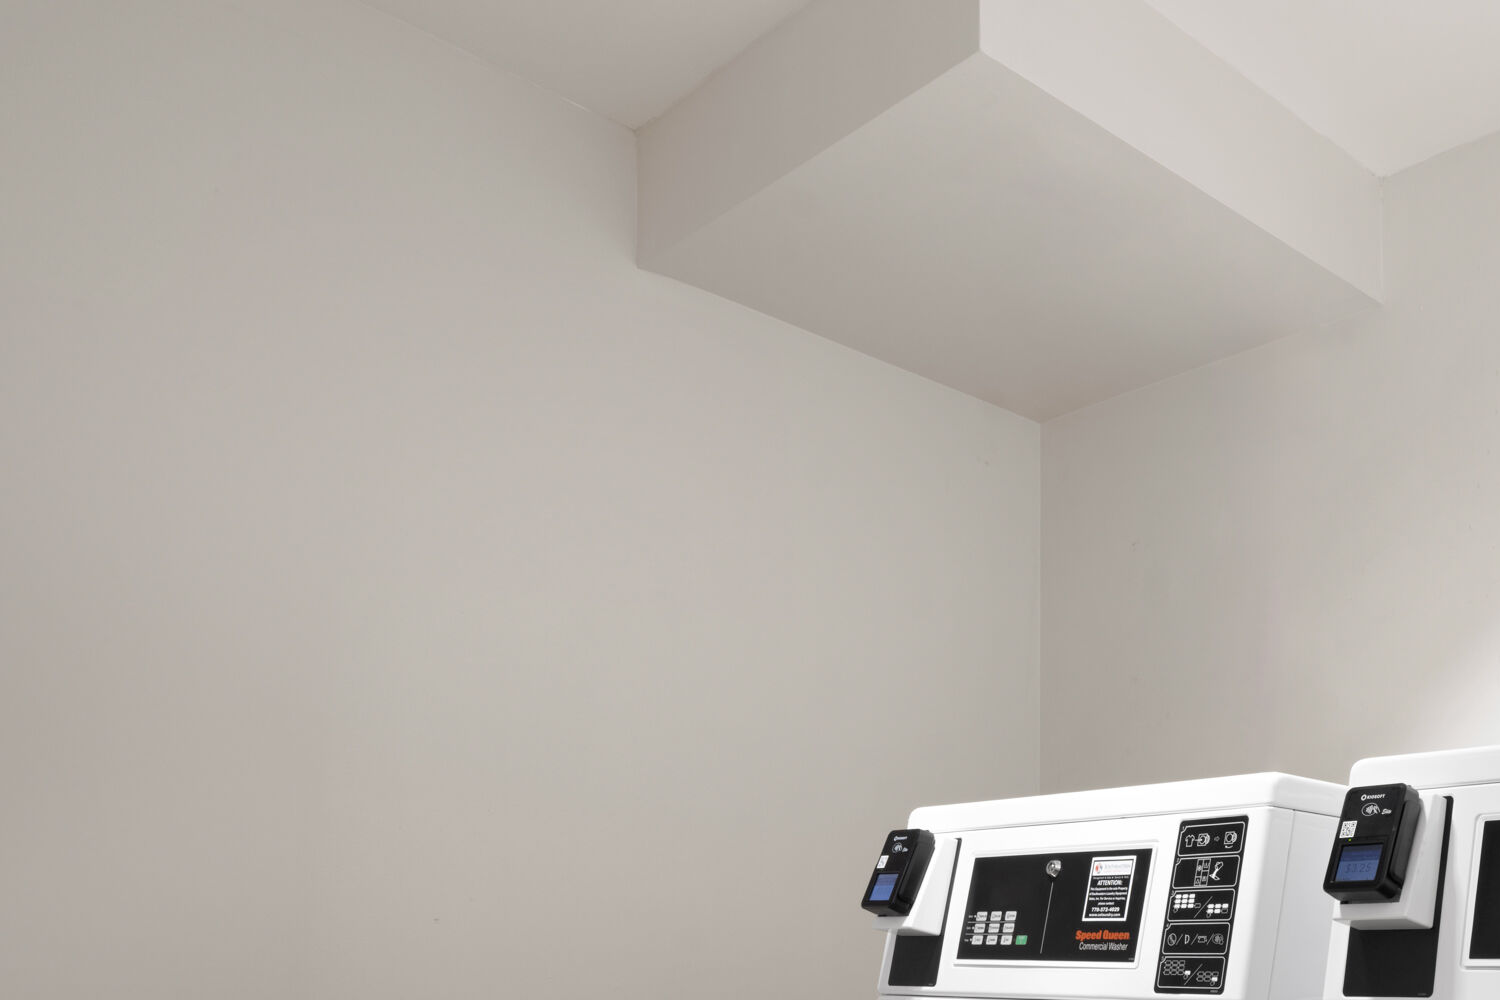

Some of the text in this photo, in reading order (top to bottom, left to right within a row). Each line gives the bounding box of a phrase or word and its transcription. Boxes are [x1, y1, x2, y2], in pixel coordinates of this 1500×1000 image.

[1075, 929, 1130, 942] Speed Queen
[1079, 941, 1128, 951] Commercial Washer
